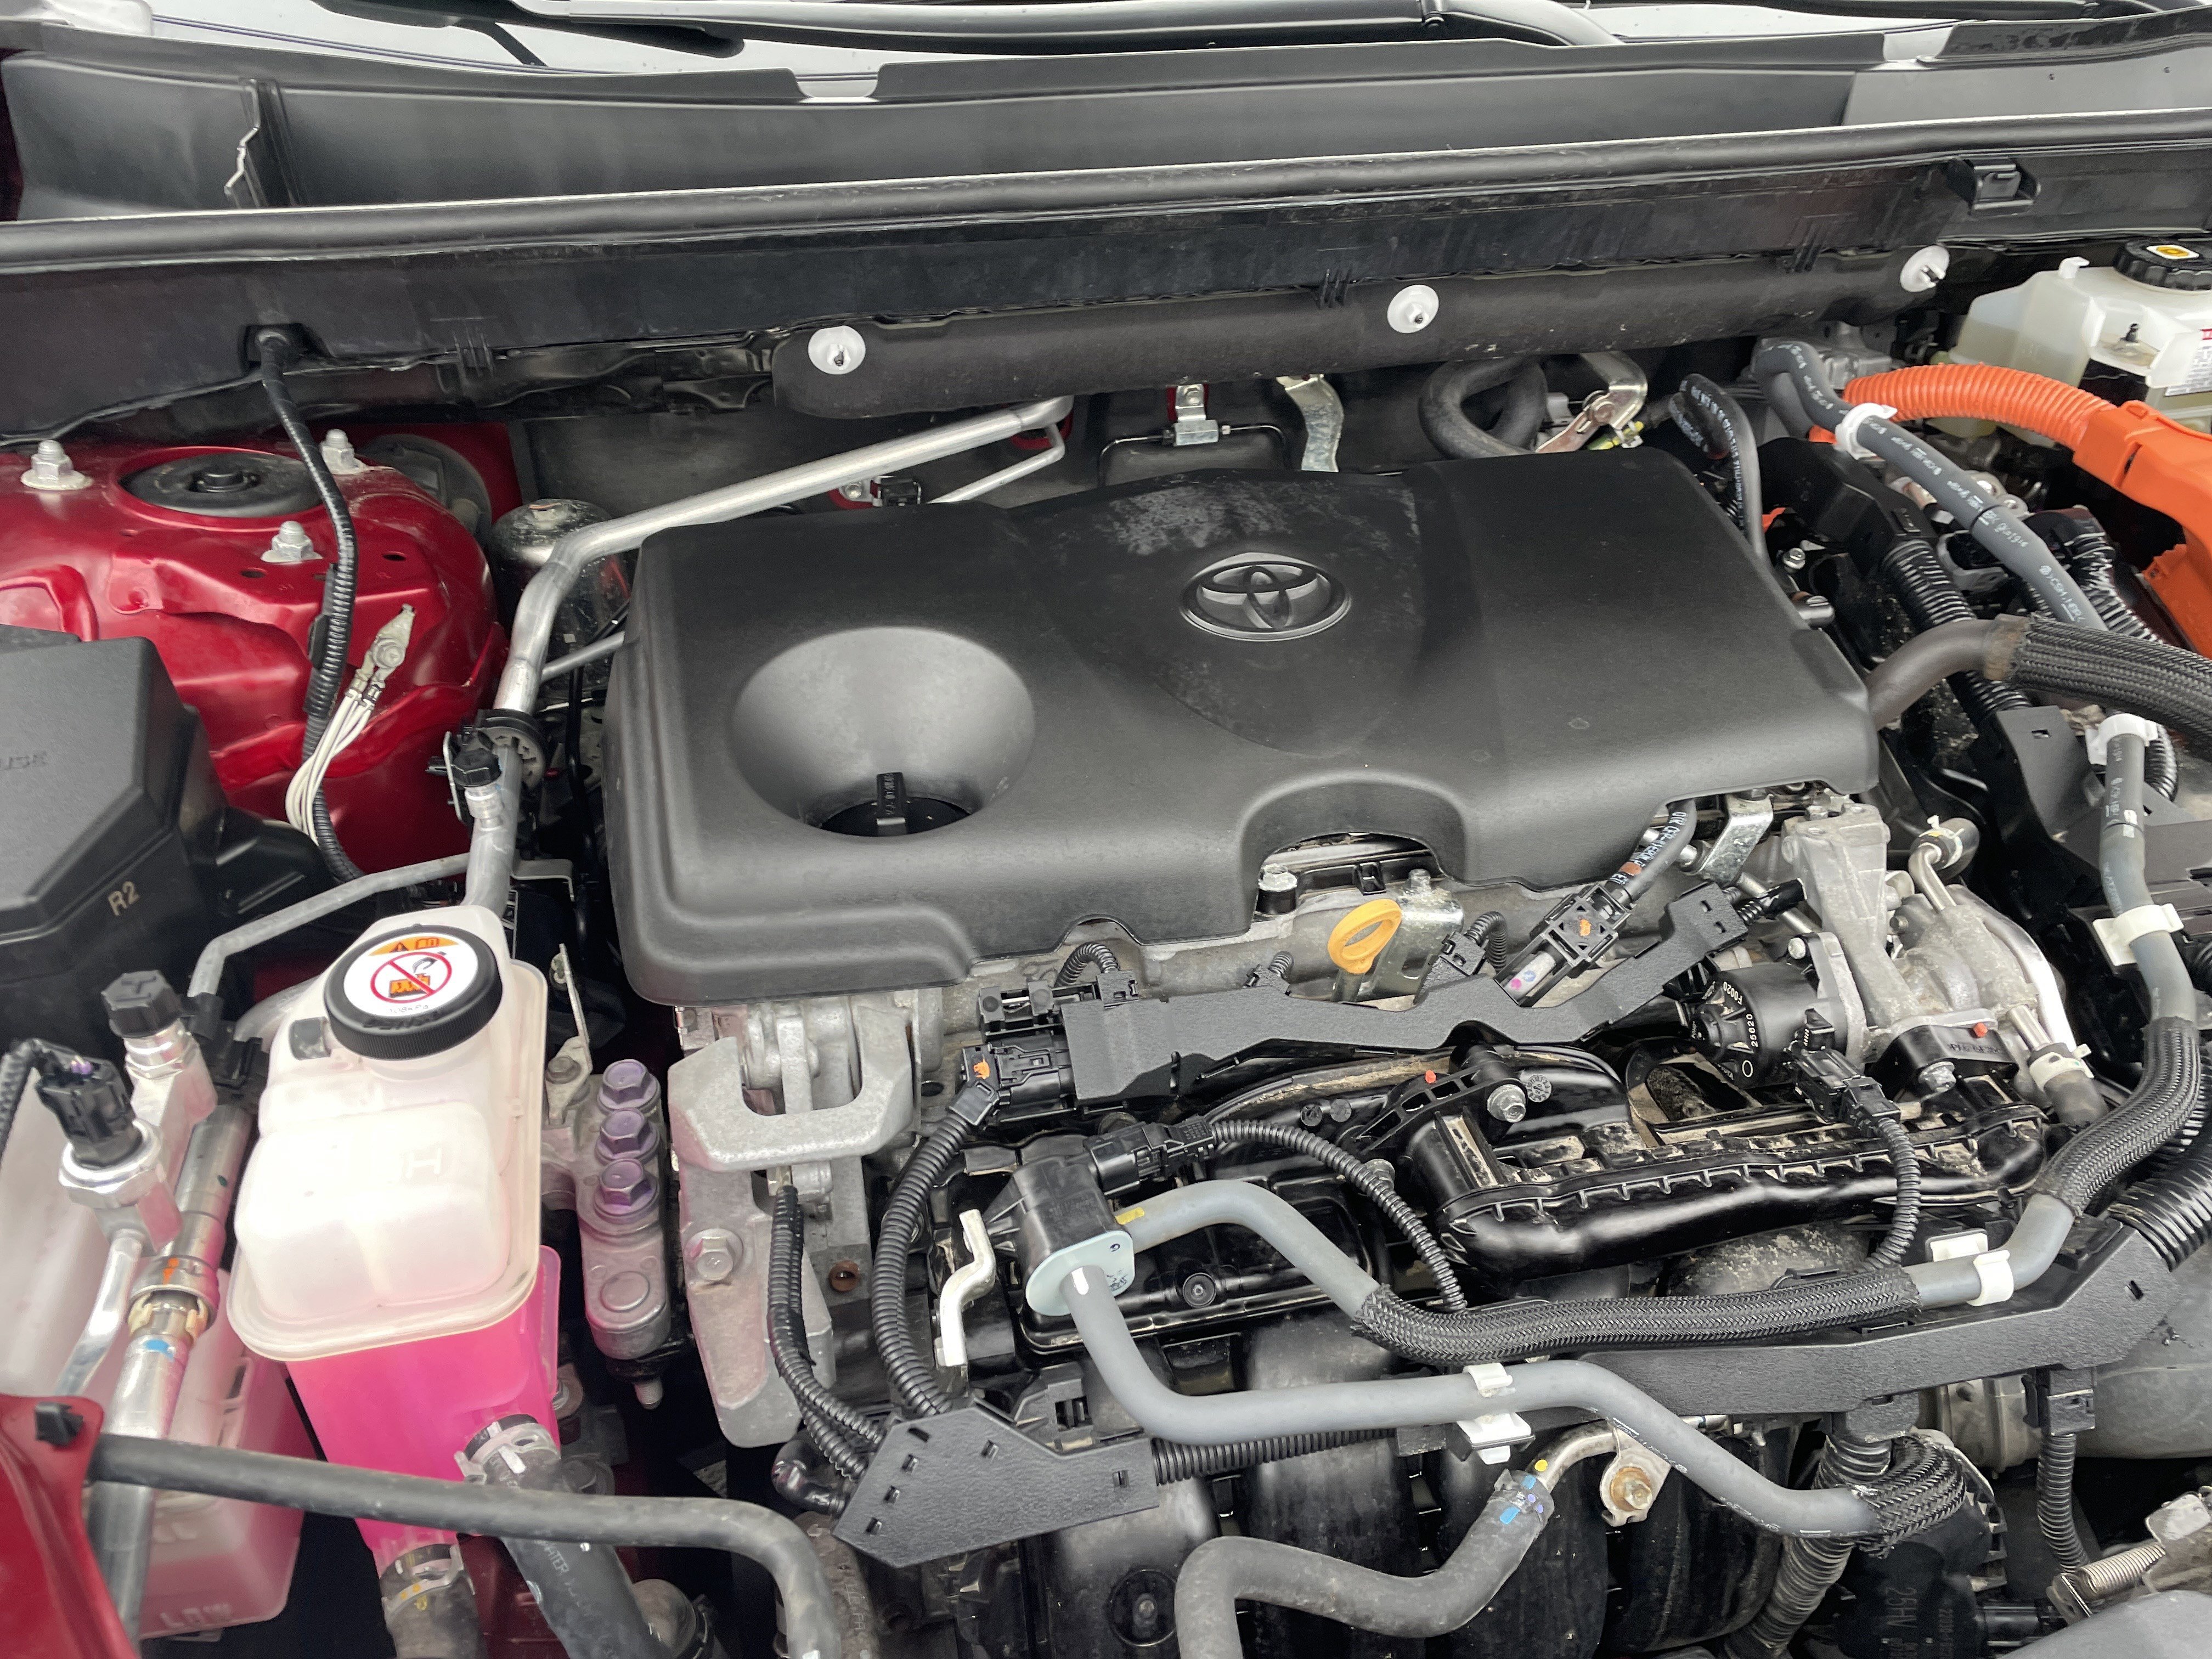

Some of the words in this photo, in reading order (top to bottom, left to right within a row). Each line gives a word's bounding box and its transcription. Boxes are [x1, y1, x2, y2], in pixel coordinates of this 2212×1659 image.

[108, 881, 140, 917] R2
[1723, 981, 1743, 1005] F0020
[1746, 1014, 1758, 1047] 25620
